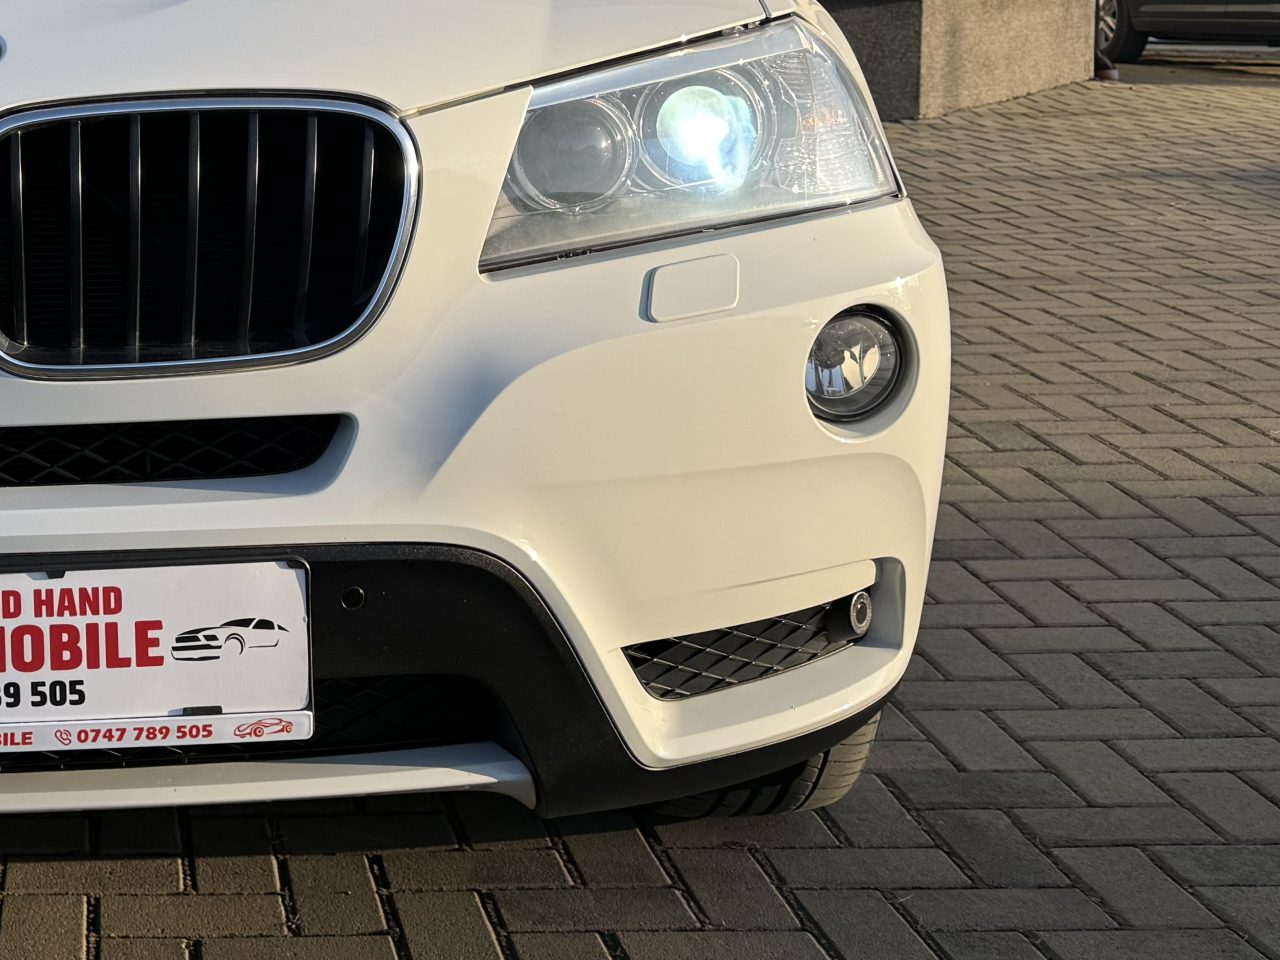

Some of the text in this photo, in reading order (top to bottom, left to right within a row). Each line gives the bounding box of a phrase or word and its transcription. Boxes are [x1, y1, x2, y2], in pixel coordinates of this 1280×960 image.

[33, 586, 123, 618] HAND
[30, 679, 86, 707] 505
[76, 723, 214, 744] 0747 789 505
